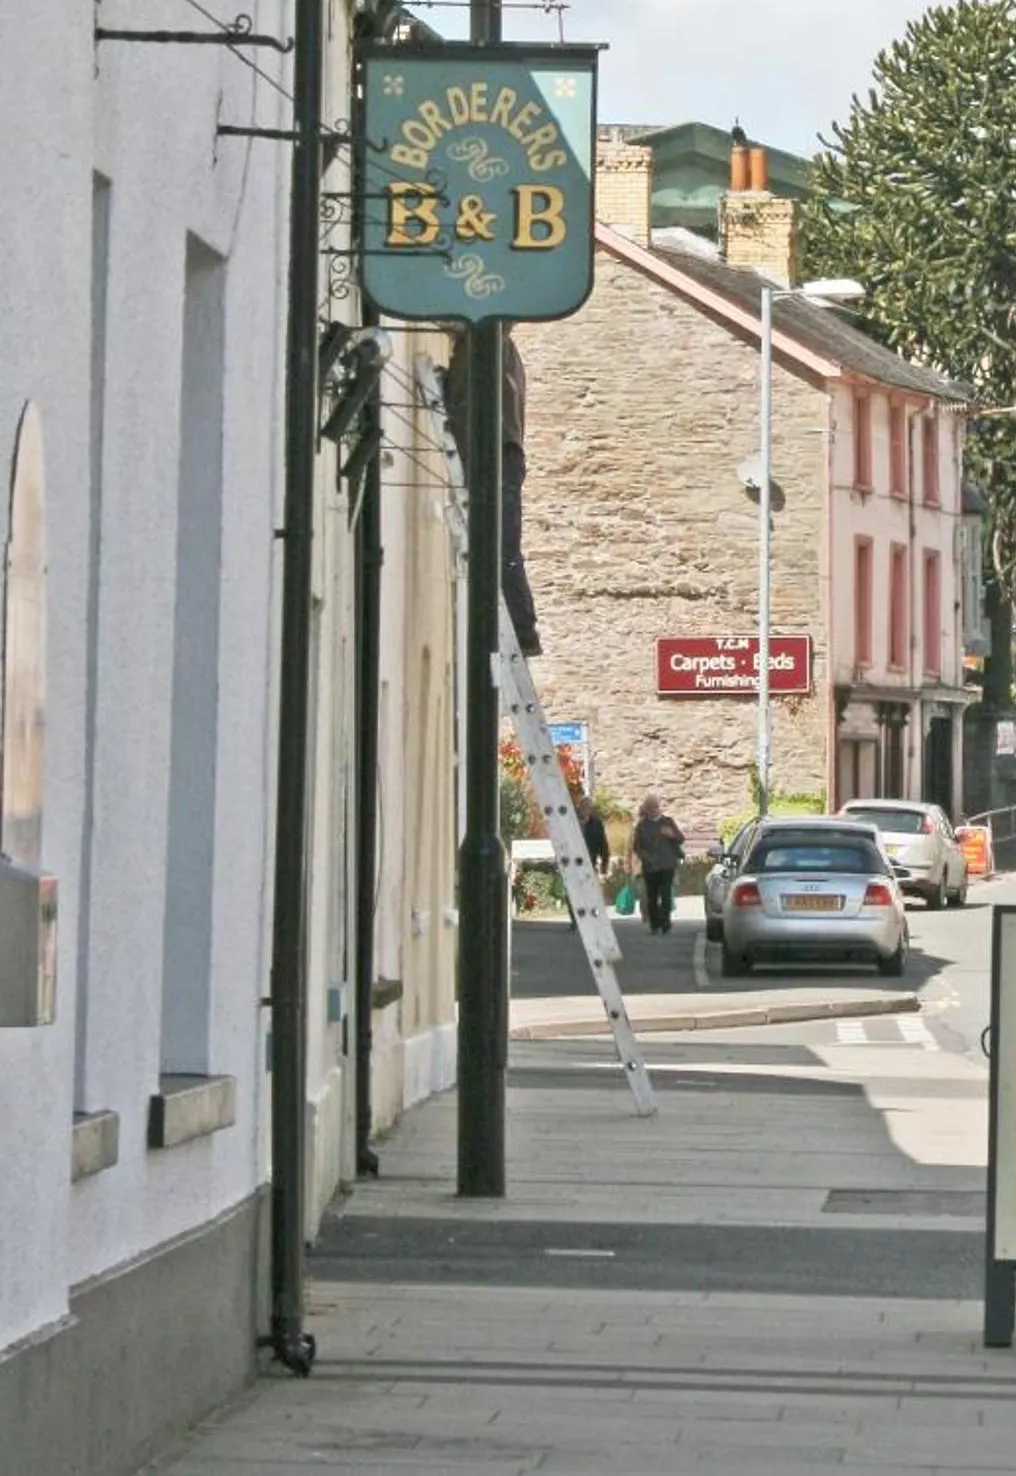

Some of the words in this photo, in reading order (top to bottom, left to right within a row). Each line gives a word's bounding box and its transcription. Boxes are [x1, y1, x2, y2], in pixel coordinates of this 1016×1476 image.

[390, 82, 567, 171] BORDERERS
[670, 654, 736, 673] Carpets
[695, 674, 768, 689] Furnishing
